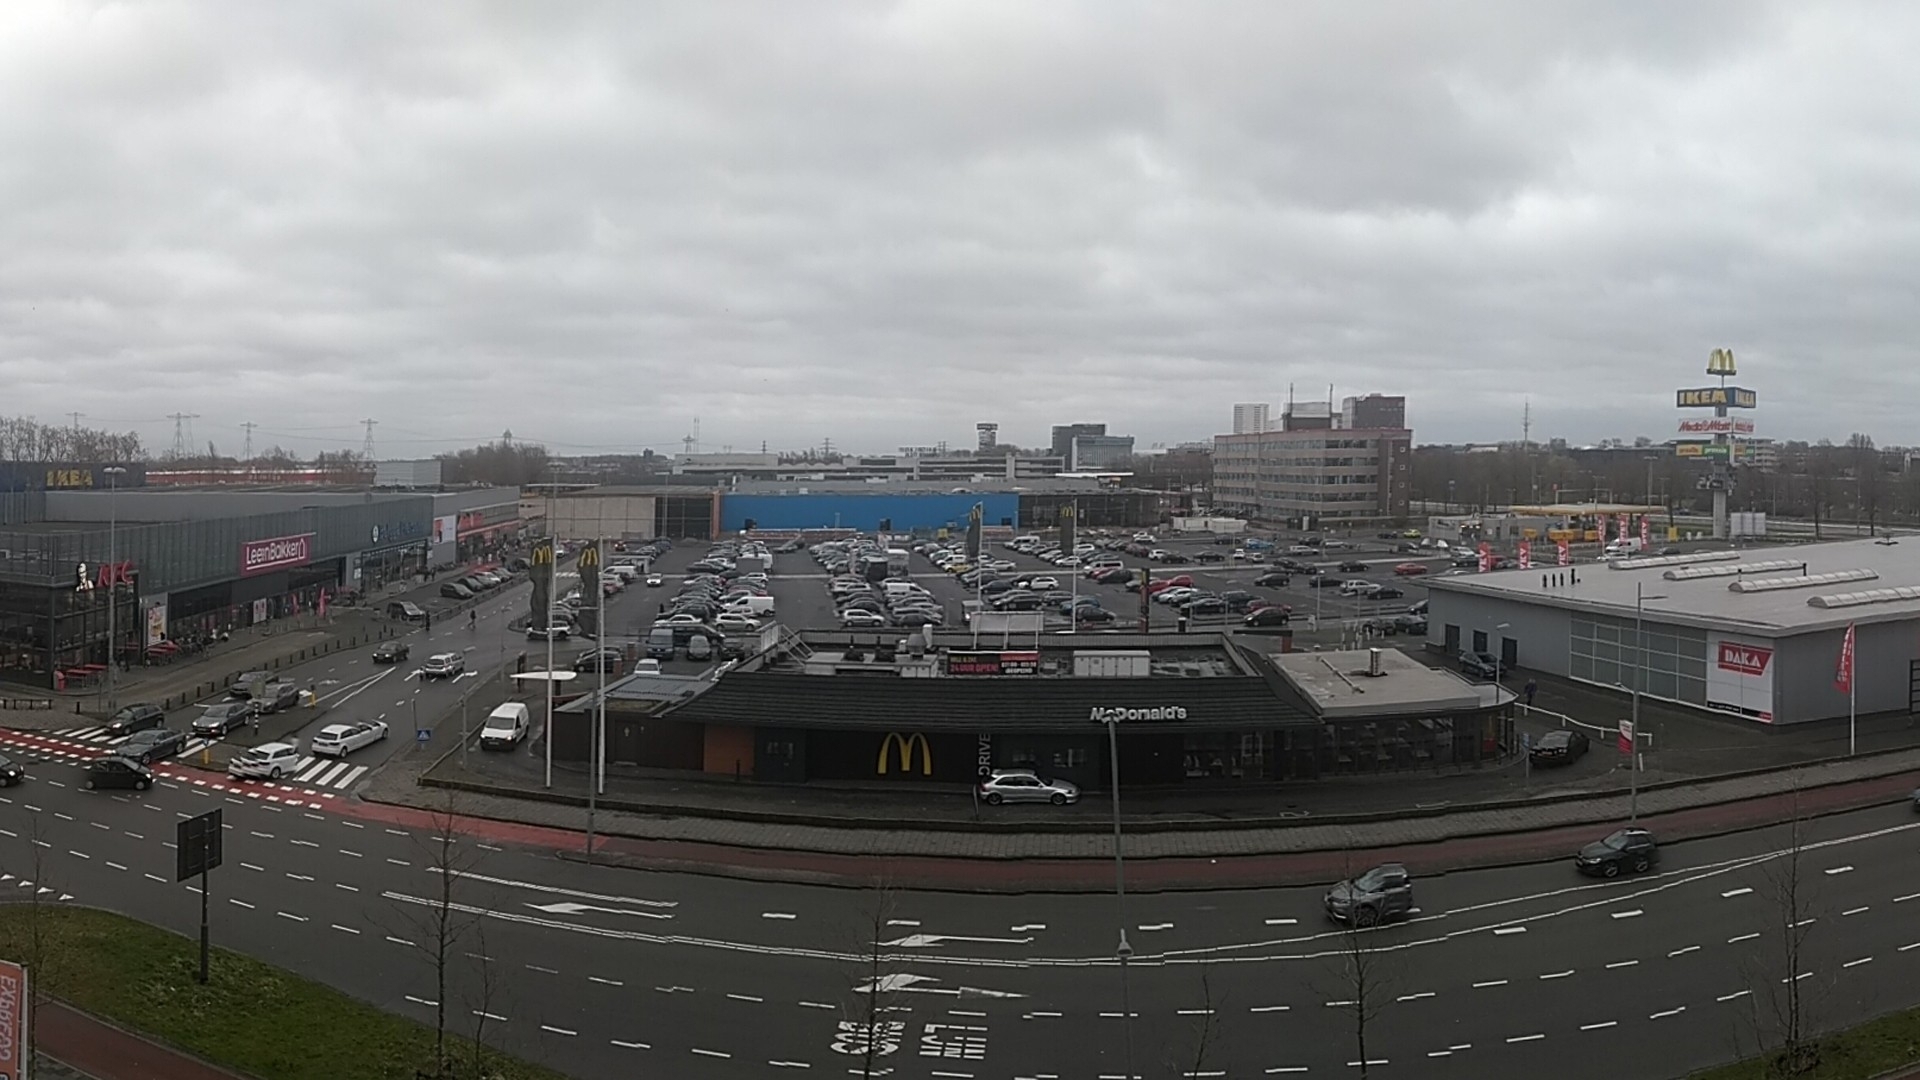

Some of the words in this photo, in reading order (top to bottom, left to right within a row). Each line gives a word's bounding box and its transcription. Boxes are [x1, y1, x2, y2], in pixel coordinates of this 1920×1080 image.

[1679, 390, 1727, 405] IKEA
[1735, 389, 1755, 406] IKEA
[47, 469, 93, 486] IKEA
[97, 559, 135, 588] KFC
[1724, 649, 1762, 668] DAKA
[978, 732, 991, 776] DRIVE
